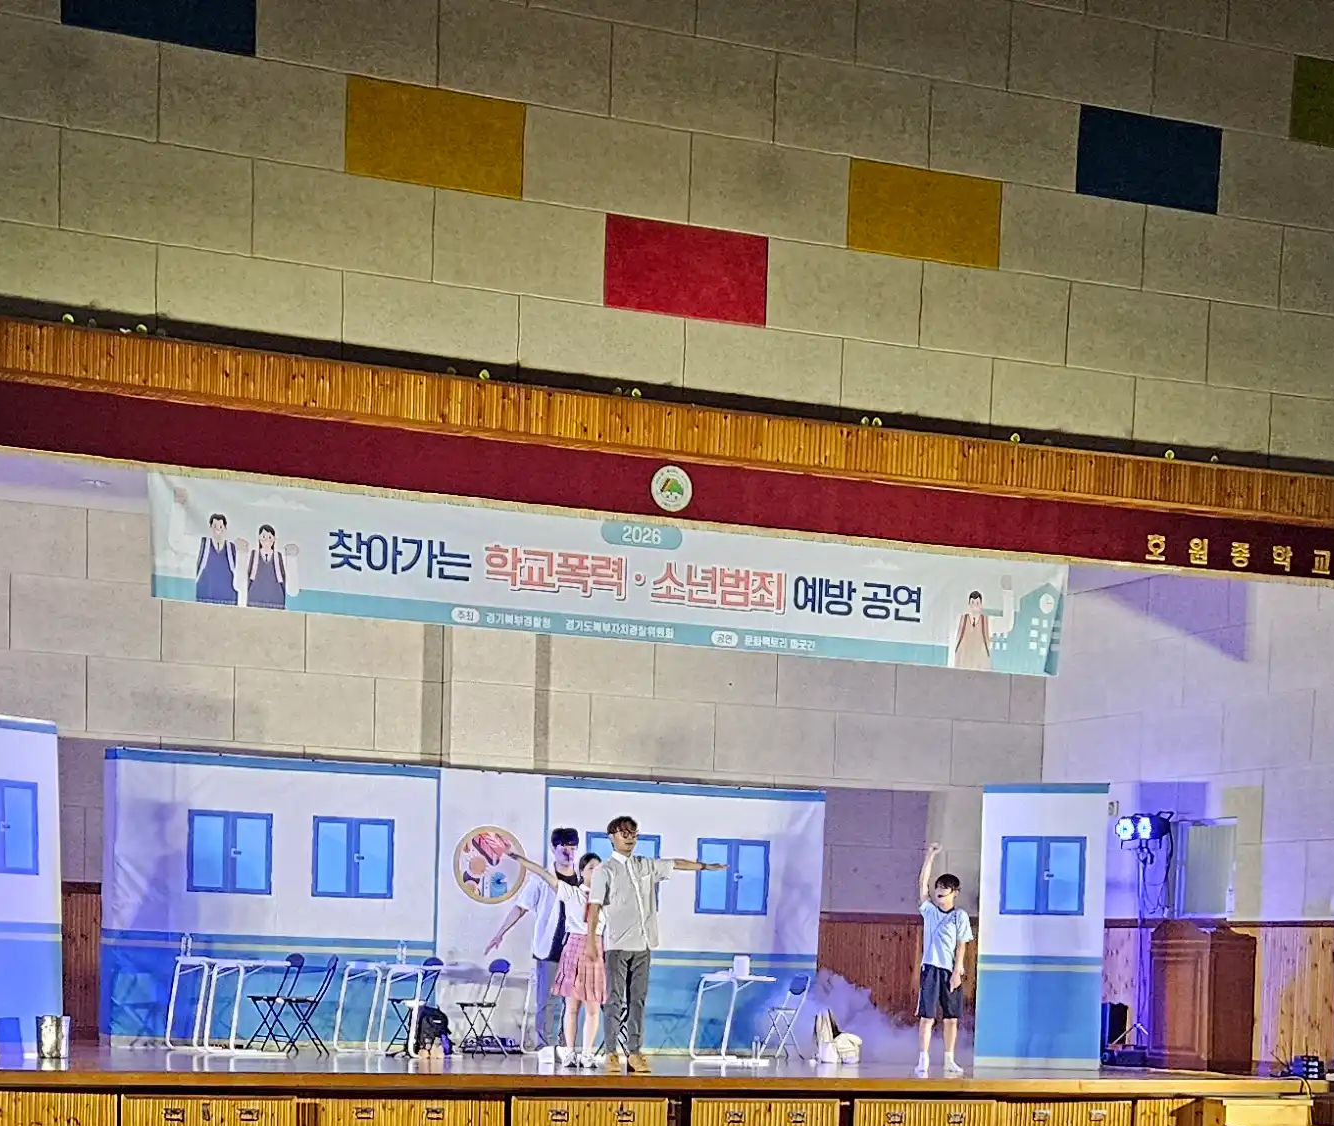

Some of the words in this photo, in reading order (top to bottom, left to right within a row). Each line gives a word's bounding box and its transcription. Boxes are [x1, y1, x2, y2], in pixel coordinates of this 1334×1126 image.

[621, 524, 662, 545] 2026
[328, 529, 473, 582] 찾아가는
[484, 543, 629, 600] 학교폭력
[650, 560, 788, 615] 소년범죄
[793, 575, 855, 616] 예방
[861, 580, 923, 624] 공연
